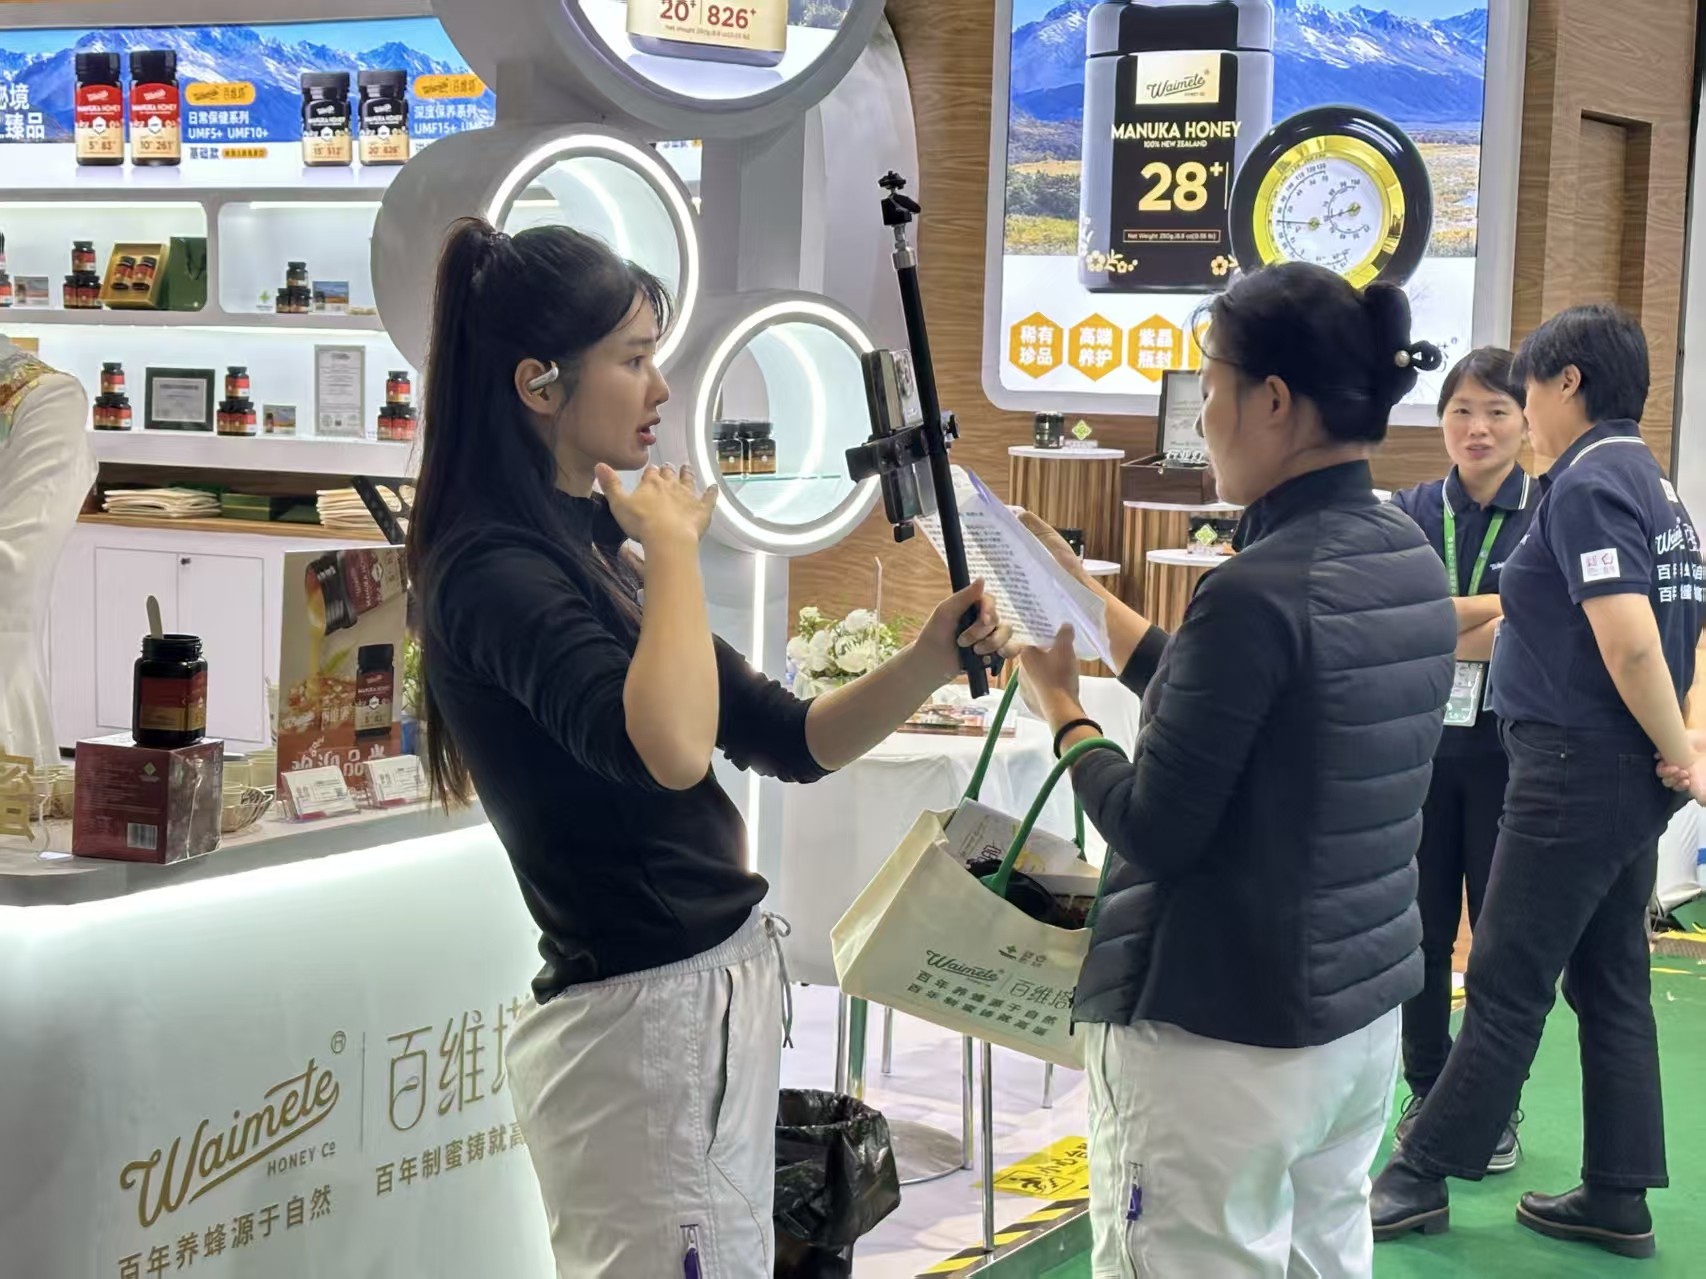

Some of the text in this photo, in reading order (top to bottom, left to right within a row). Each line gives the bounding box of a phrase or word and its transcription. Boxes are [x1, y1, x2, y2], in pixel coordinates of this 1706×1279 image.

[188, 127, 269, 139] UMF5+ UMF10+
[1111, 120, 1241, 139] MANUKA HONEY
[1139, 161, 1224, 211] 28+
[1019, 347, 1053, 366] 珍品
[119, 1057, 341, 1229] Waimete
[267, 1146, 315, 1178] HONEY
[118, 1184, 332, 1279] 百年养蜂源于自然
